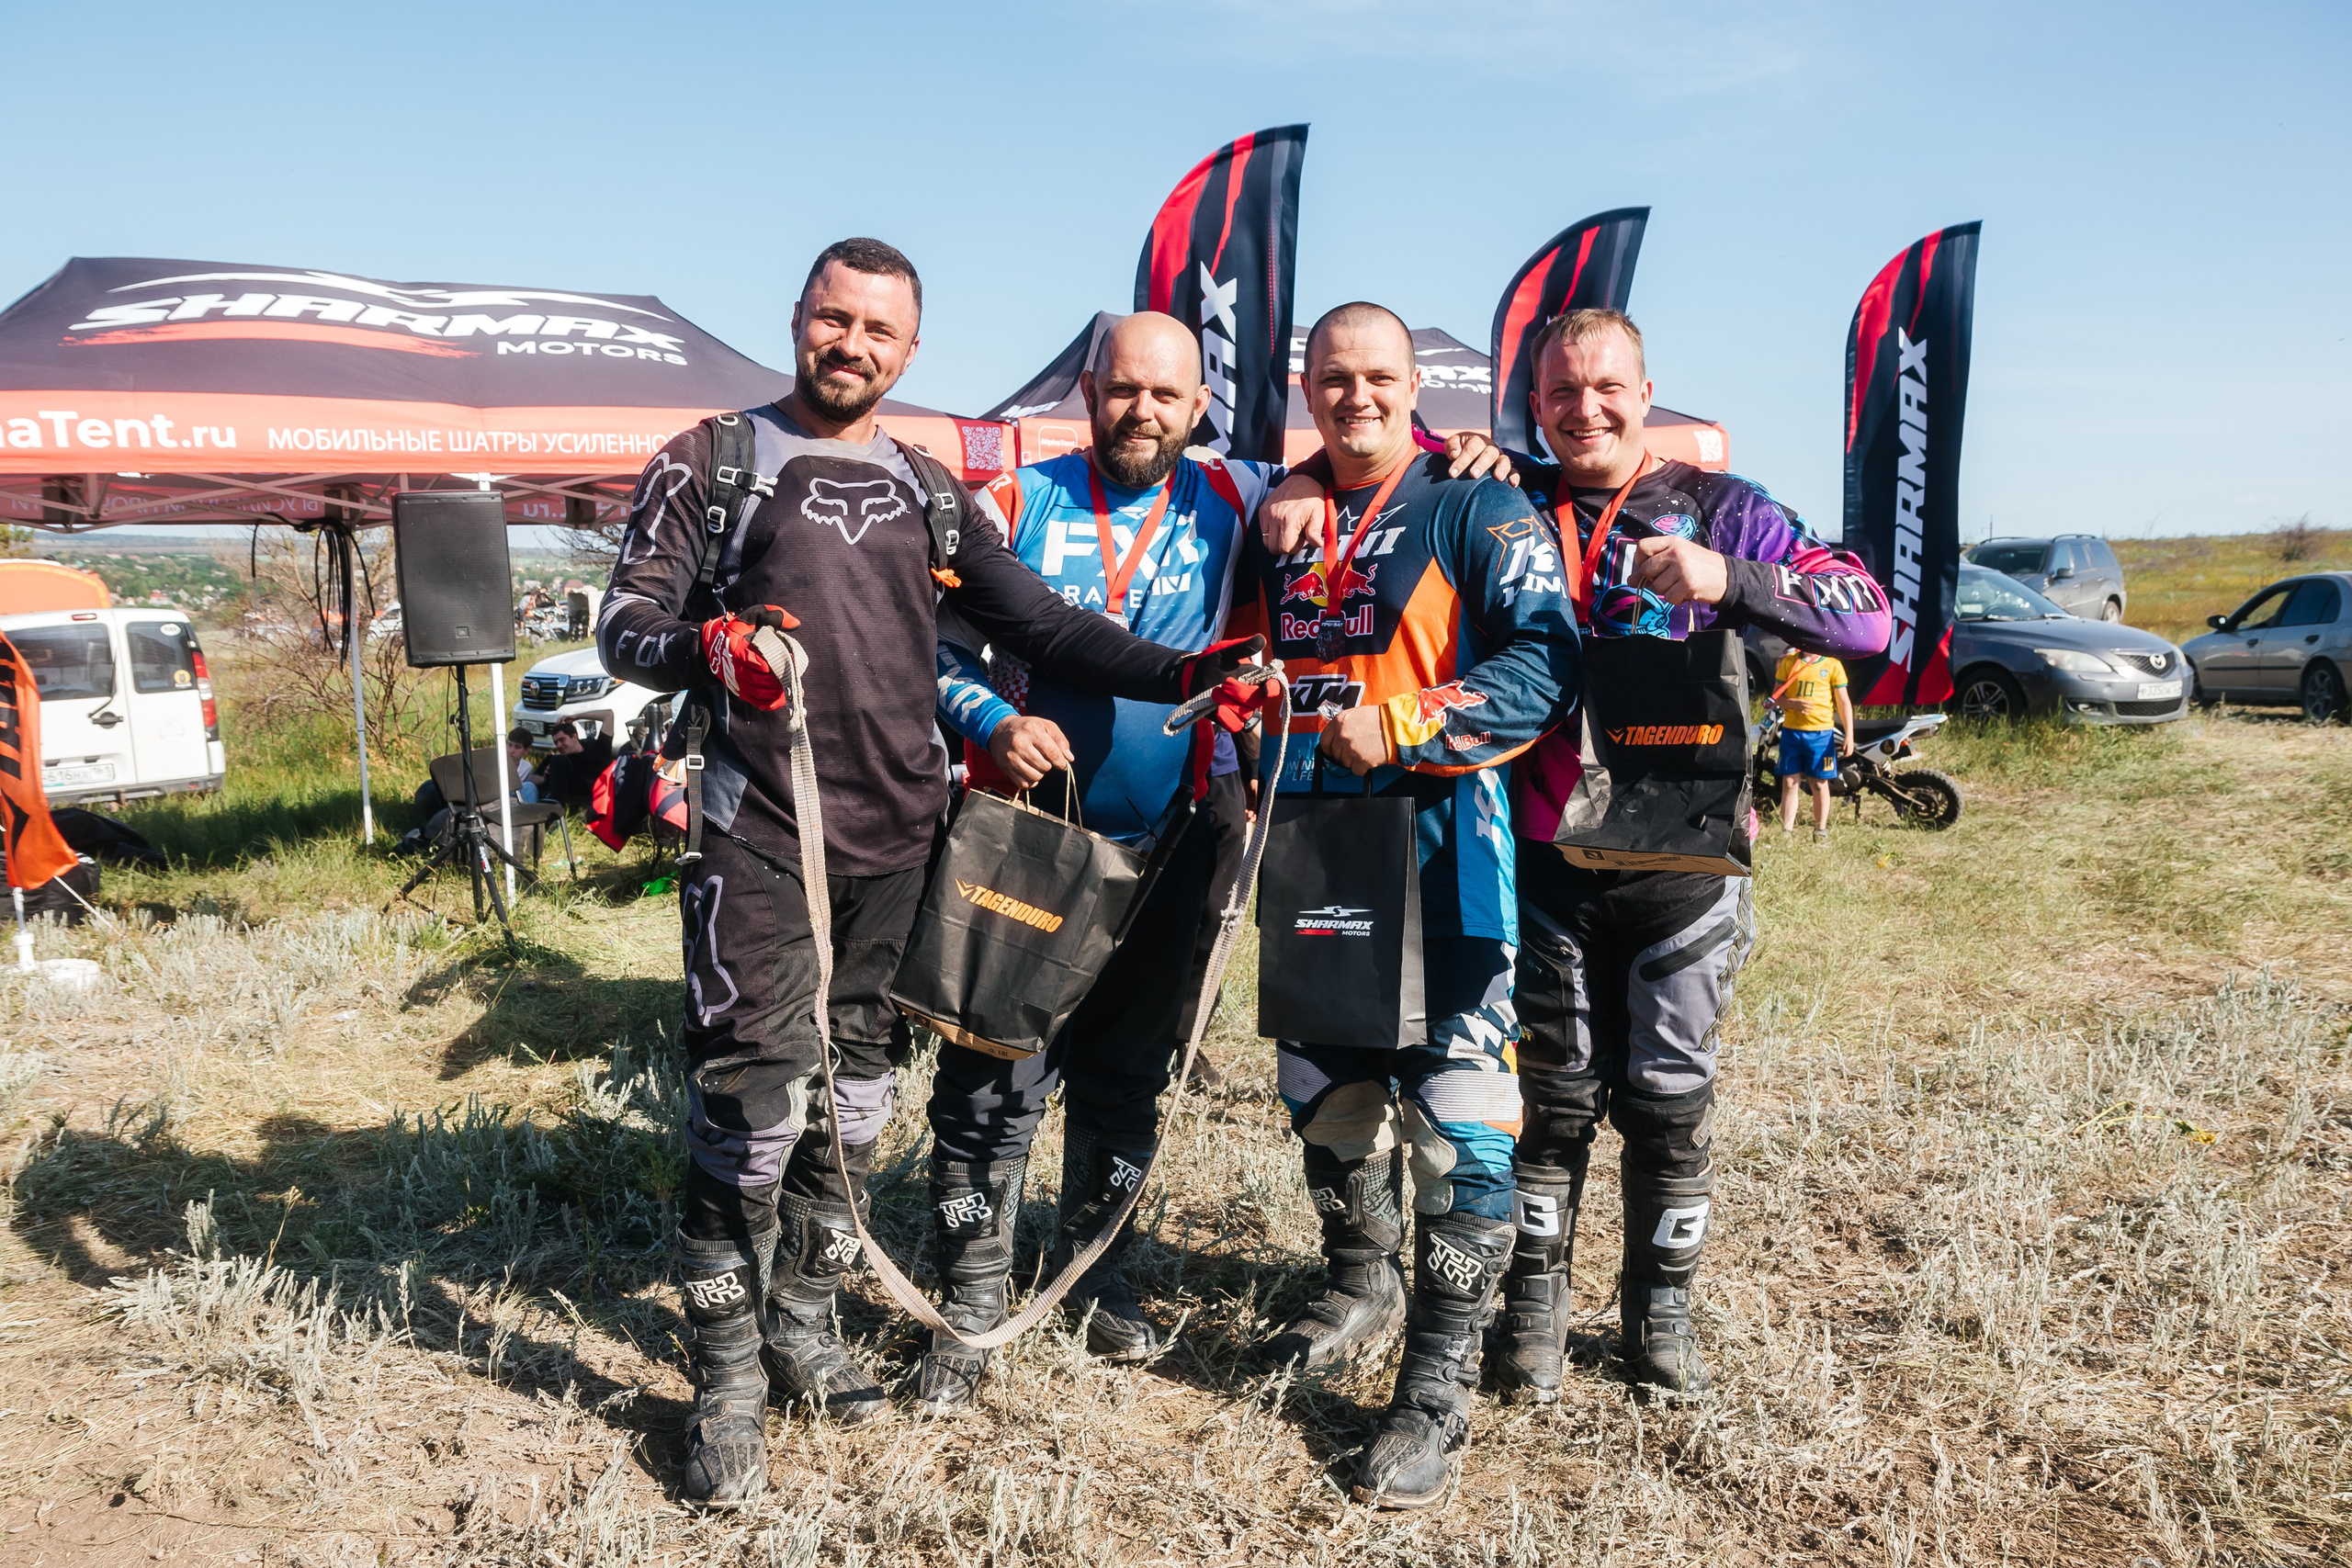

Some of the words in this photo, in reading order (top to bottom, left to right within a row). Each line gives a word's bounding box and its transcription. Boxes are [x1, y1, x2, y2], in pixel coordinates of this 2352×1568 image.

[70, 293, 686, 353] SHARMAX
[497, 340, 688, 367] MOTORS
[0, 411, 236, 448] aTent.ru
[268, 427, 442, 452] МОБИЛЬНЫЕ
[448, 430, 537, 453] ШАТРЫ
[545, 431, 680, 454] УСИЛЕННО
[1889, 326, 1928, 672] SHARMAX
[1063, 584, 1144, 609] RAE
[1341, 604, 1374, 637] ull
[616, 629, 678, 668] FOX
[1280, 674, 1366, 716] KTM
[1796, 680, 1815, 697] 10
[1462, 731, 1491, 751] Bull
[1624, 724, 1724, 746] TAGENDURO
[969, 885, 1064, 933] TAGENDURO
[1294, 919, 1374, 931] SHARMAX
